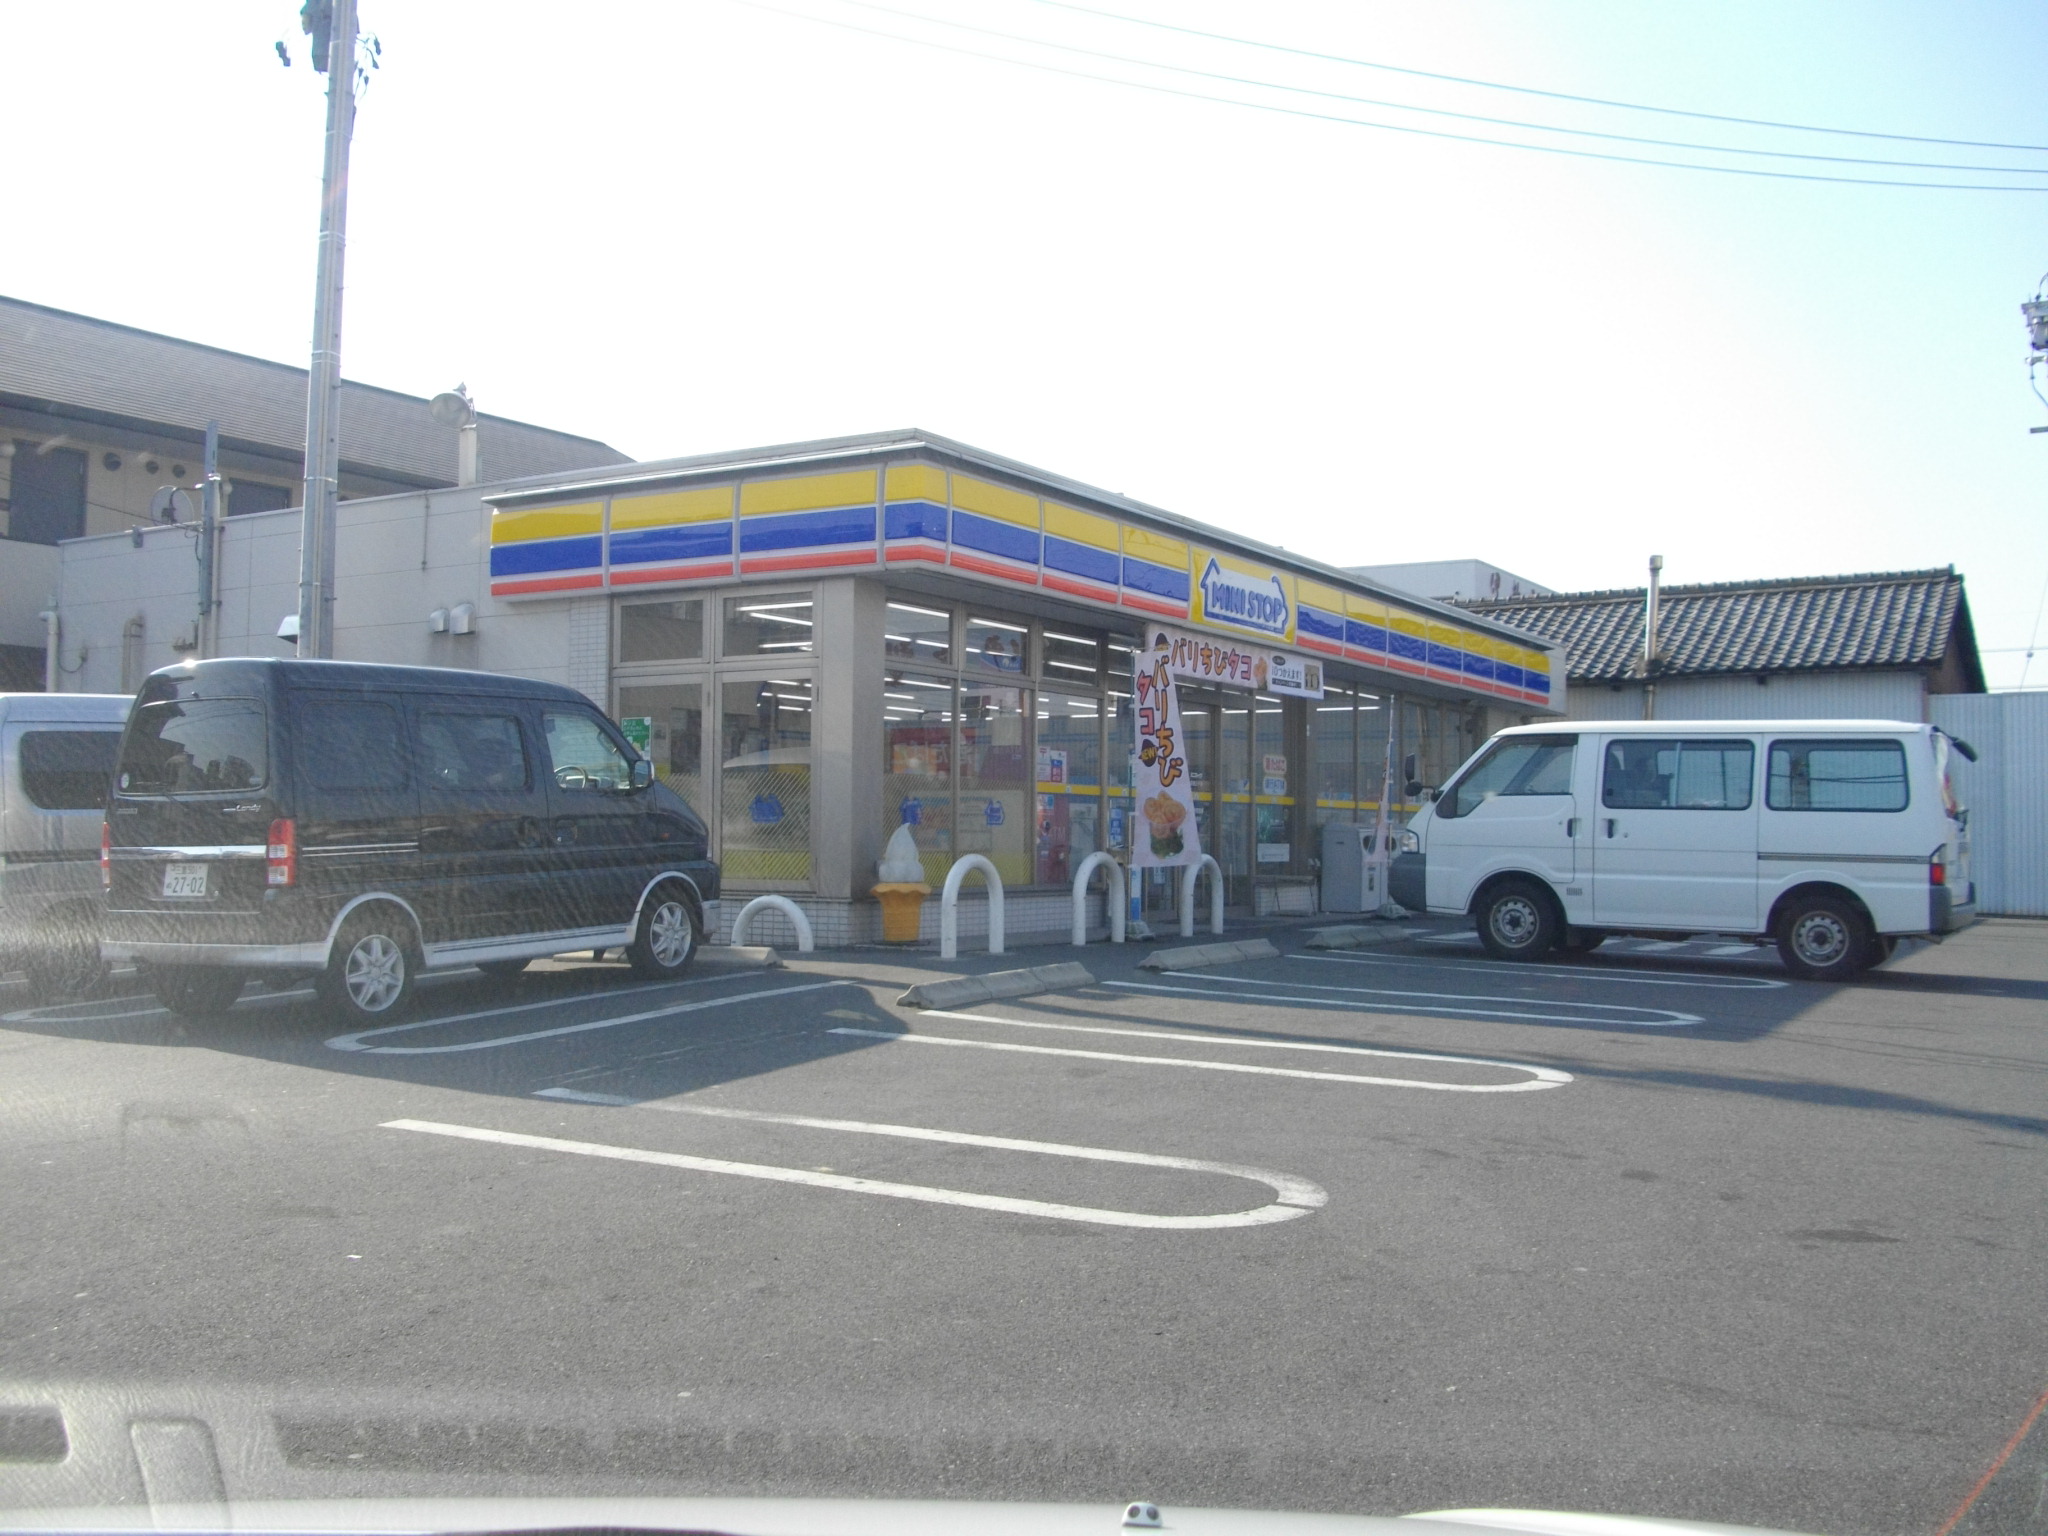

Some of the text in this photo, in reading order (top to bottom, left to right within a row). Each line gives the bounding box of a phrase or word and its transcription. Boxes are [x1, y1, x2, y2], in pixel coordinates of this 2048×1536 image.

[1212, 581, 1284, 623] MINI STOP
[1171, 637, 1252, 681] バリちびタコ
[1136, 669, 1155, 735] タコ
[1151, 655, 1183, 787] バリちび
